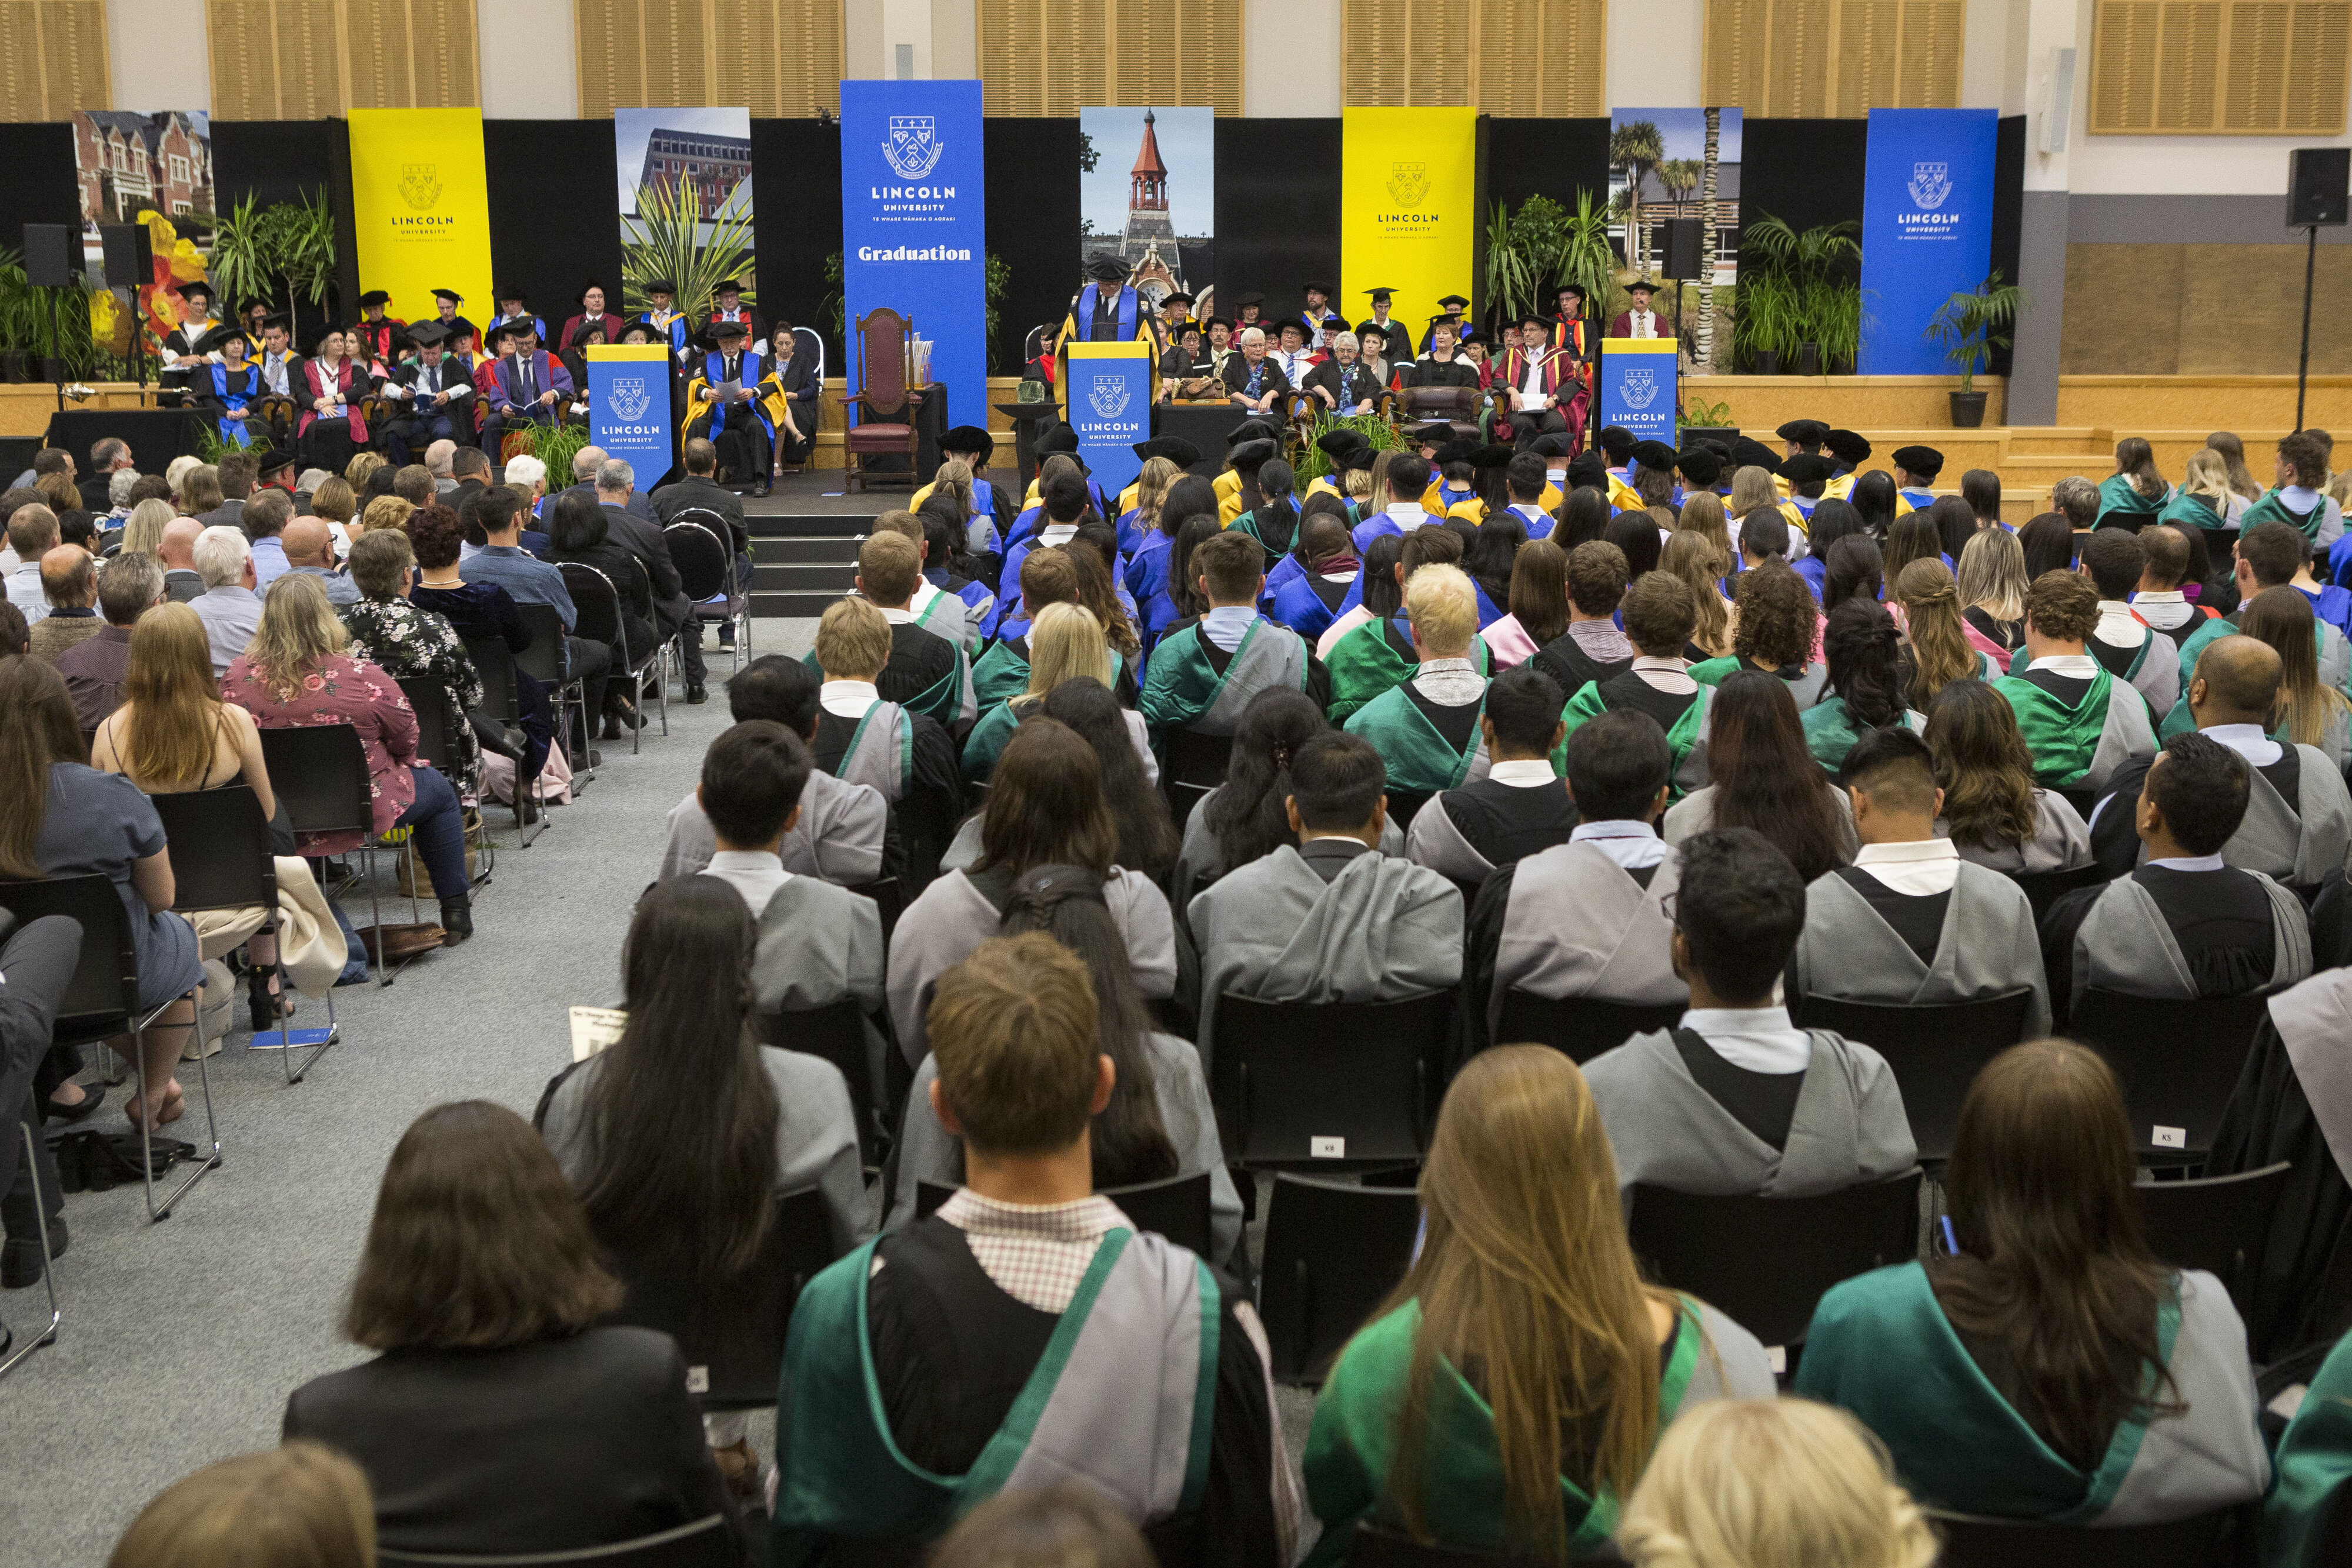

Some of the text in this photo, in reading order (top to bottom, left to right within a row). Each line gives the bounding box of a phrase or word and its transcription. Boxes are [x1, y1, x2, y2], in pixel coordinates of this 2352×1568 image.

[872, 186, 955, 199] LINCOLN
[392, 216, 453, 225] LINCOLN
[1378, 214, 1439, 222] LINCOLN
[1898, 213, 1959, 223] LINCOLN
[858, 245, 970, 261] Graduation
[602, 426, 659, 434] LINCOLN
[1081, 423, 1138, 431] LINCOLN
